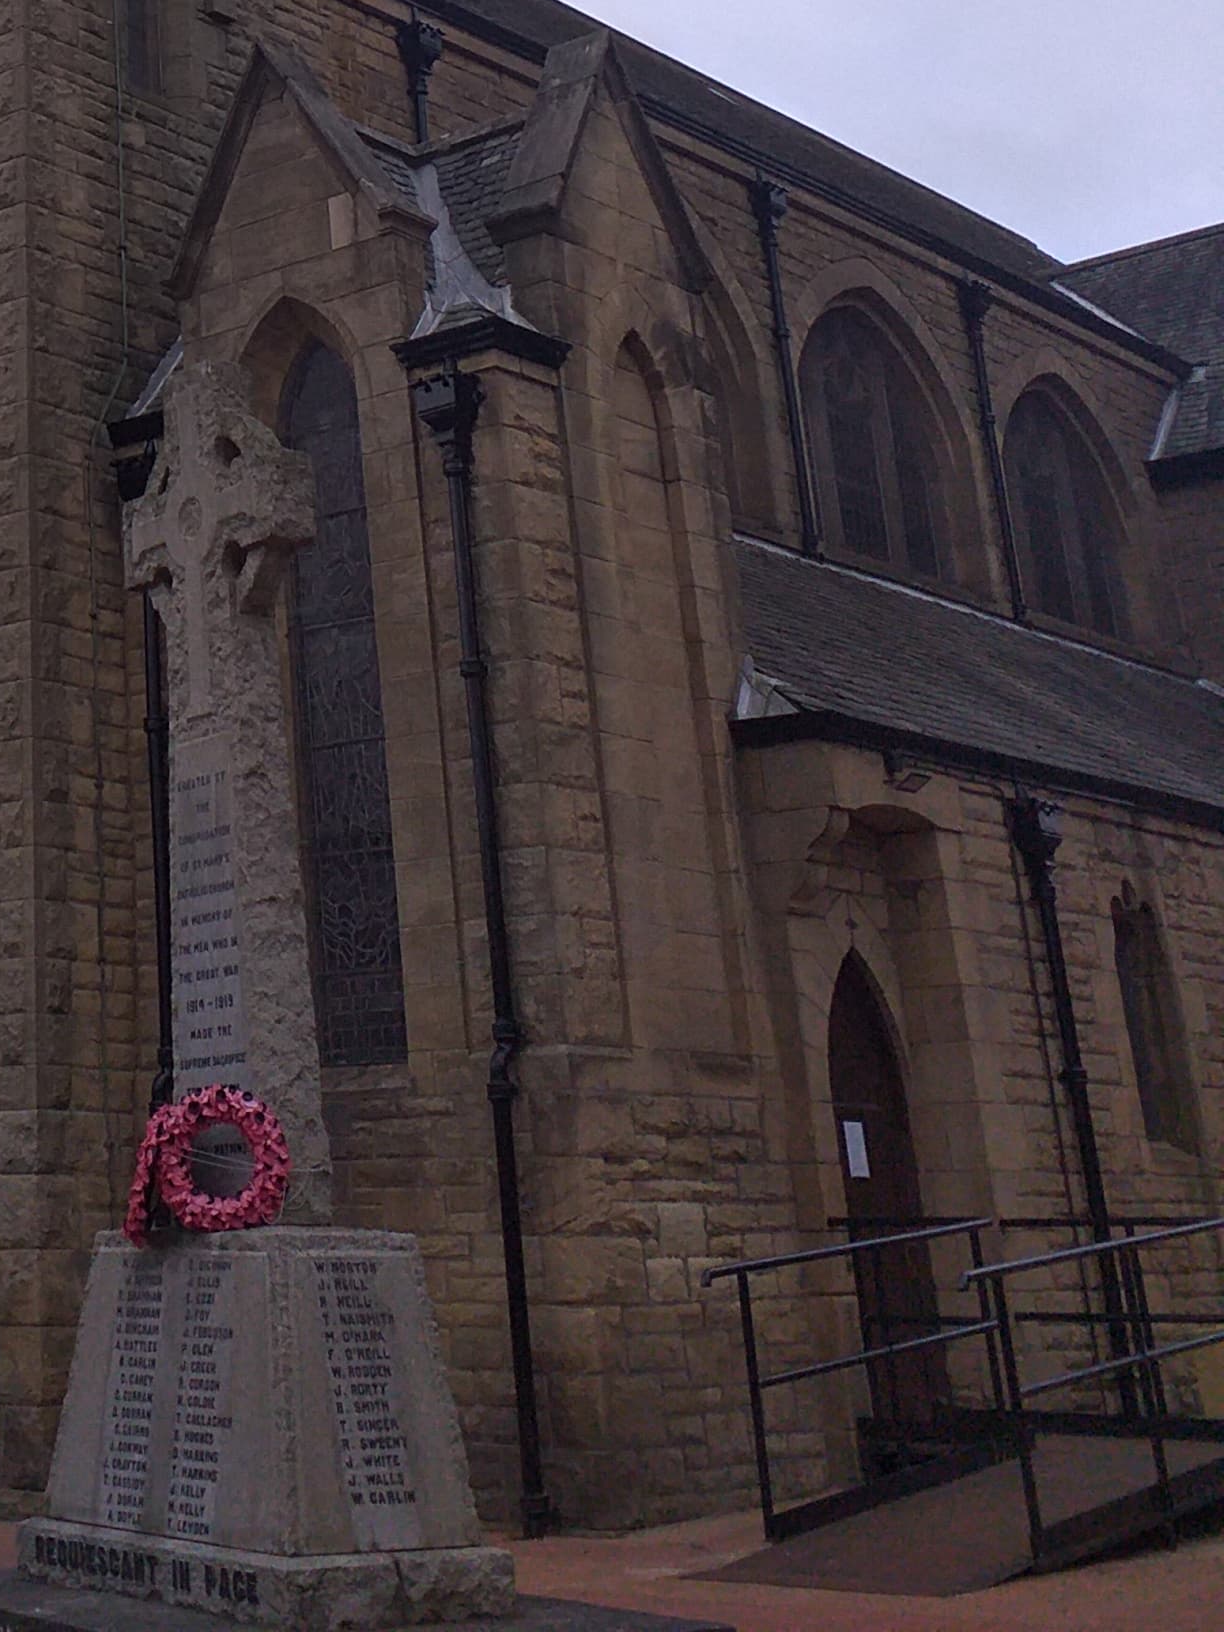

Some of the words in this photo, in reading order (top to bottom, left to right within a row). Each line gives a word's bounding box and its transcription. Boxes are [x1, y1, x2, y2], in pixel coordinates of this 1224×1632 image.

[178, 943, 192, 956] THE
[193, 940, 209, 953] MEN
[212, 937, 228, 950] WHO
[179, 972, 193, 984] THE
[196, 968, 220, 981] GREAT
[223, 965, 239, 978] WAR
[190, 1027, 213, 1040] MADE
[217, 1024, 232, 1037] THE
[180, 1056, 211, 1071] SUPREME
[330, 1261, 378, 1275] NORTON
[197, 1276, 221, 1289] ELLIS
[341, 1329, 386, 1343] O'HARA
[334, 1383, 348, 1396] J.
[353, 1399, 391, 1415] SMITH
[356, 1417, 401, 1433] SINGER
[183, 1431, 215, 1446] HUGHES
[359, 1435, 410, 1450] SWEENY
[363, 1454, 402, 1468] WHITE
[181, 1466, 220, 1483] HARKINS
[347, 1472, 362, 1486] J.
[365, 1471, 406, 1486] WALLS
[180, 1484, 208, 1499] KELLY
[369, 1488, 418, 1505] CARLIN
[178, 1501, 206, 1518] KELLY
[176, 1519, 210, 1536] LEYDEN
[34, 1533, 159, 1586] REQUIESCANT
[171, 1558, 192, 1594] IN
[204, 1563, 260, 1606] PACE
